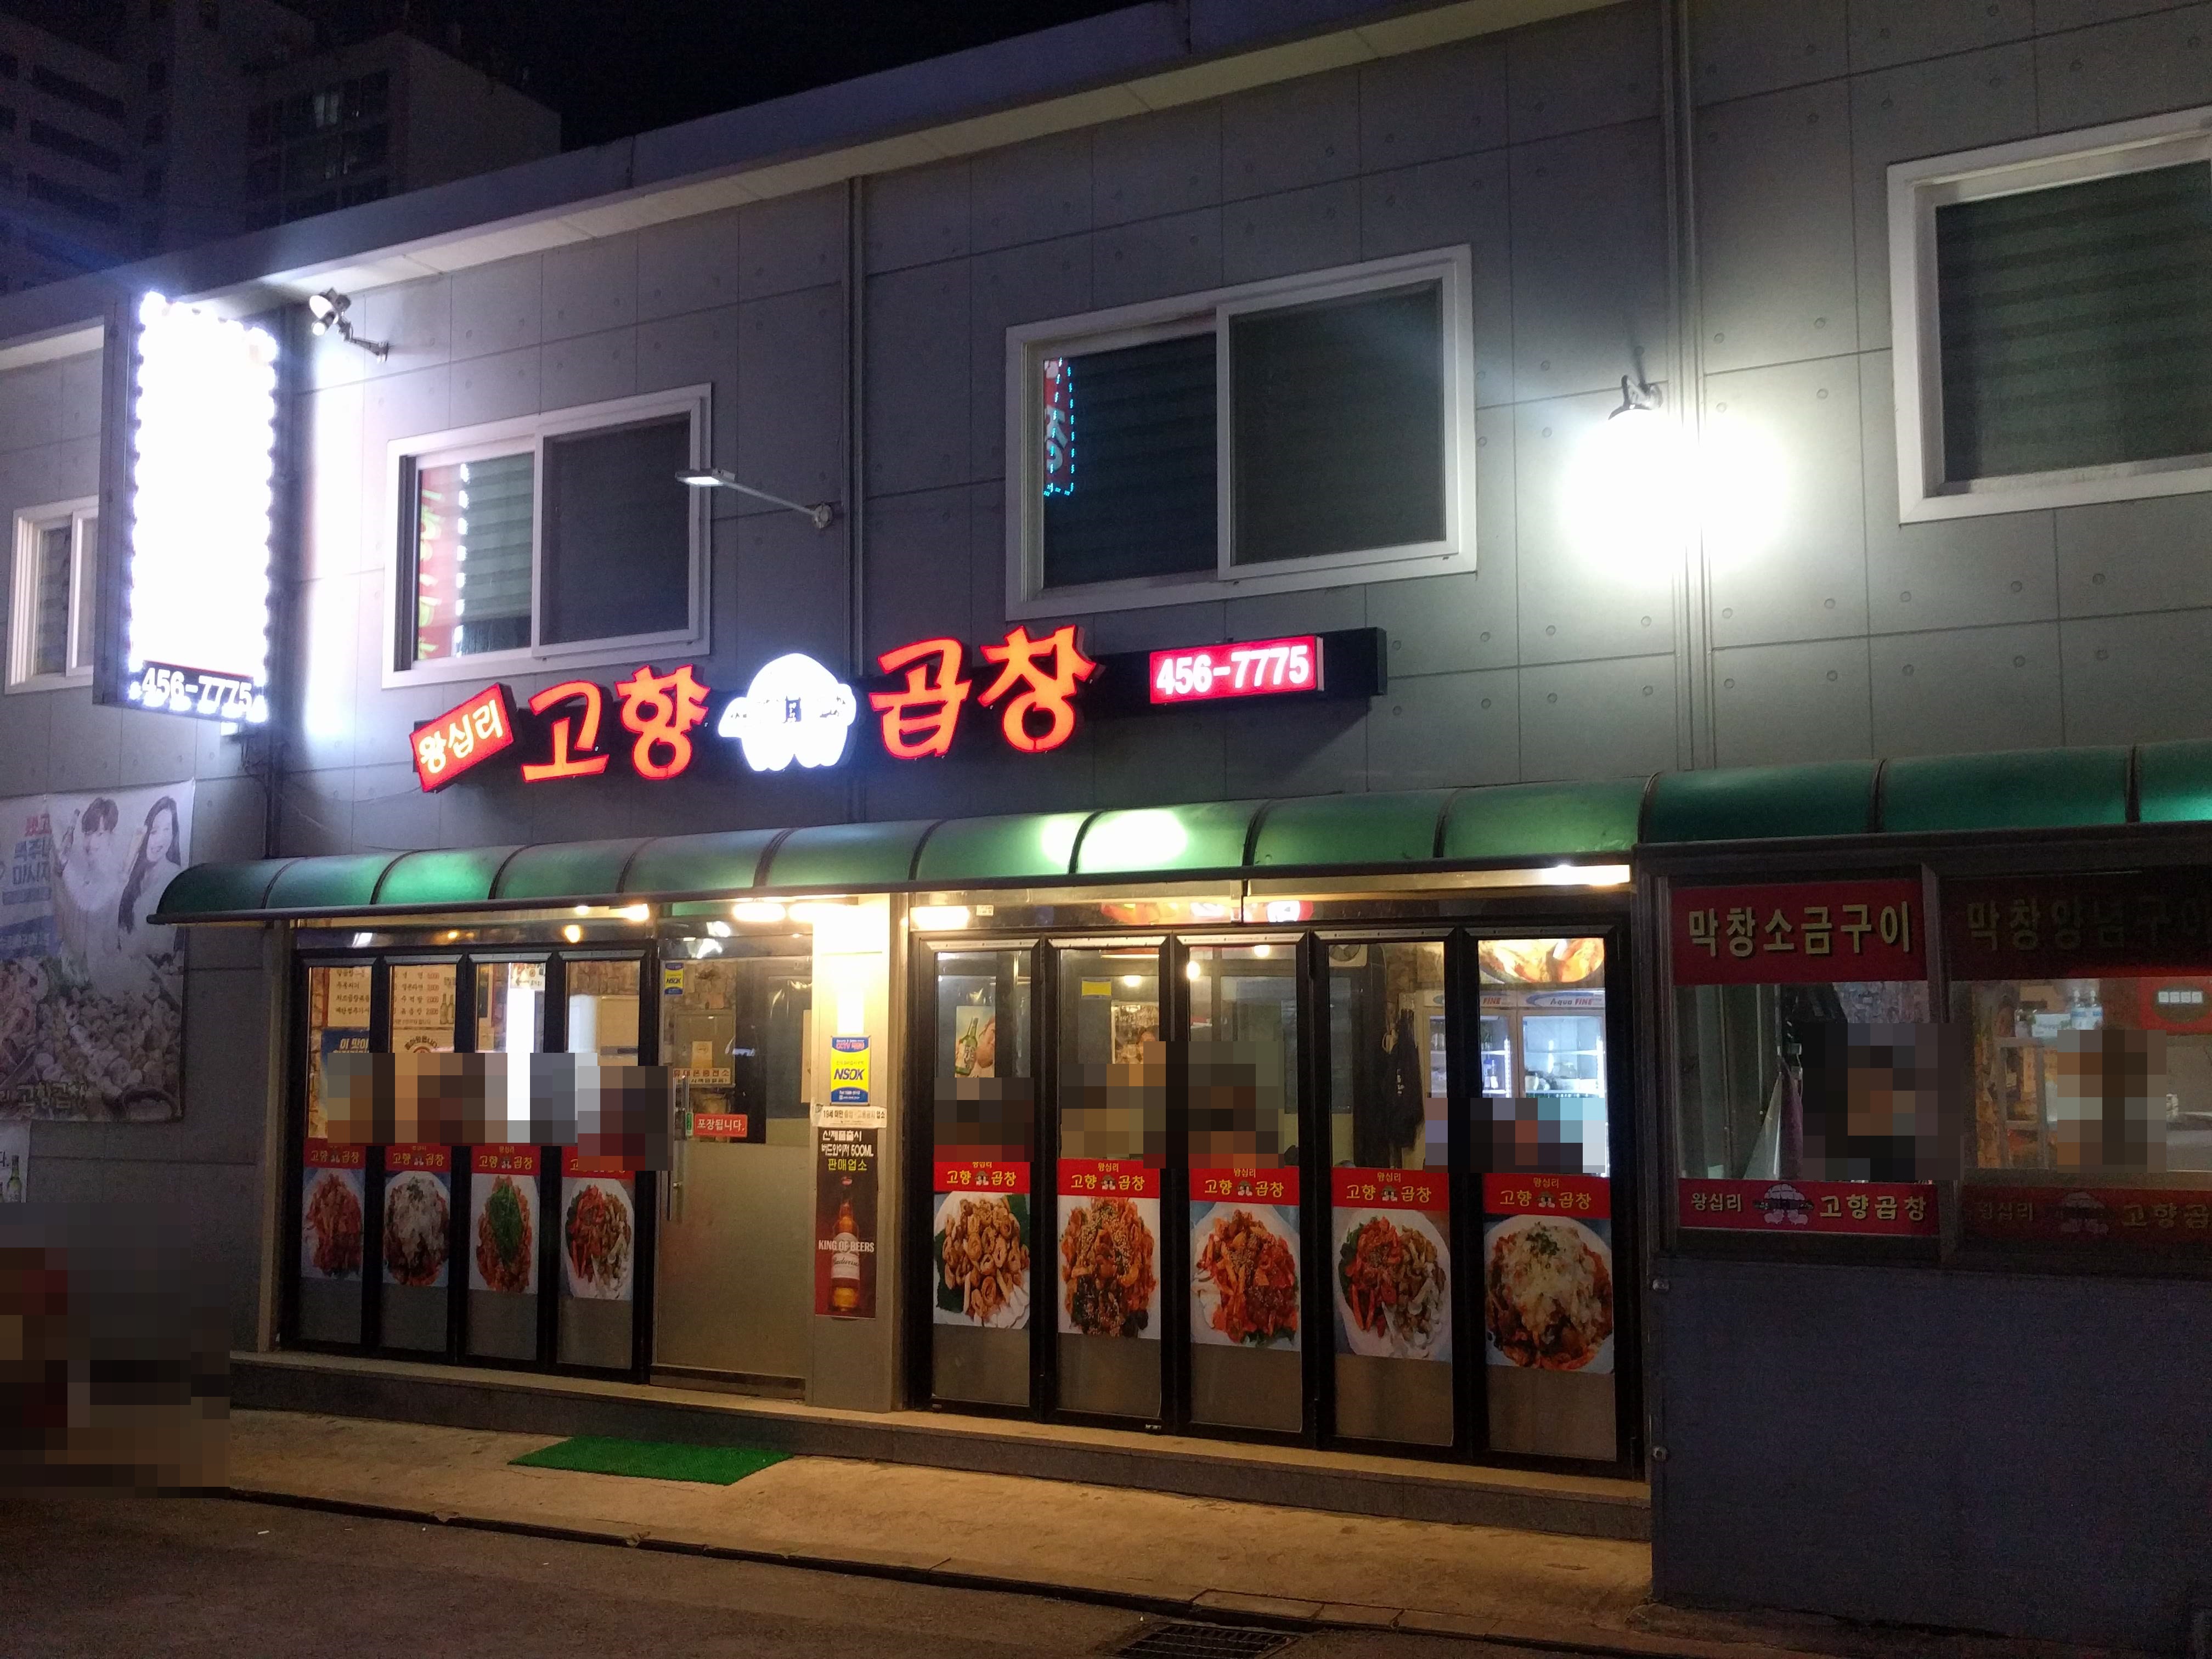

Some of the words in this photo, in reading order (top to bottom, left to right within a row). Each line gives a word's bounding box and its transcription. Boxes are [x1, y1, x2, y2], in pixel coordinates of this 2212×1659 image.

[1156, 645, 1310, 695] 456-7775
[142, 668, 252, 712] 456-7775
[522, 664, 710, 783] 고향
[869, 626, 1094, 760] 곱창
[419, 699, 503, 773] 왕십리
[1689, 901, 1909, 957] 막창소금구이
[834, 1068, 865, 1080] NSOK
[851, 1144, 874, 1157] 500ML
[828, 1158, 867, 1171] 판매업소
[1098, 1162, 1119, 1172] 왕십리
[946, 1170, 971, 1185] 고향
[991, 1171, 1017, 1187] 곱창
[1071, 1174, 1097, 1189] 고향
[1119, 1175, 1145, 1190] 곱창
[1204, 1179, 1232, 1195] 고향
[1255, 1181, 1284, 1198] 곱창
[1346, 1184, 1376, 1200] 고향
[1401, 1186, 1431, 1203] 곱창
[1499, 1190, 1532, 1207] 고향
[1559, 1192, 1592, 1210] 곱창
[1691, 1193, 1741, 1212] 왕십리
[1820, 1194, 1927, 1221] 고향곱창
[819, 1239, 837, 1251] KING
[839, 1240, 849, 1251] OF
[850, 1241, 874, 1252] BEERS
